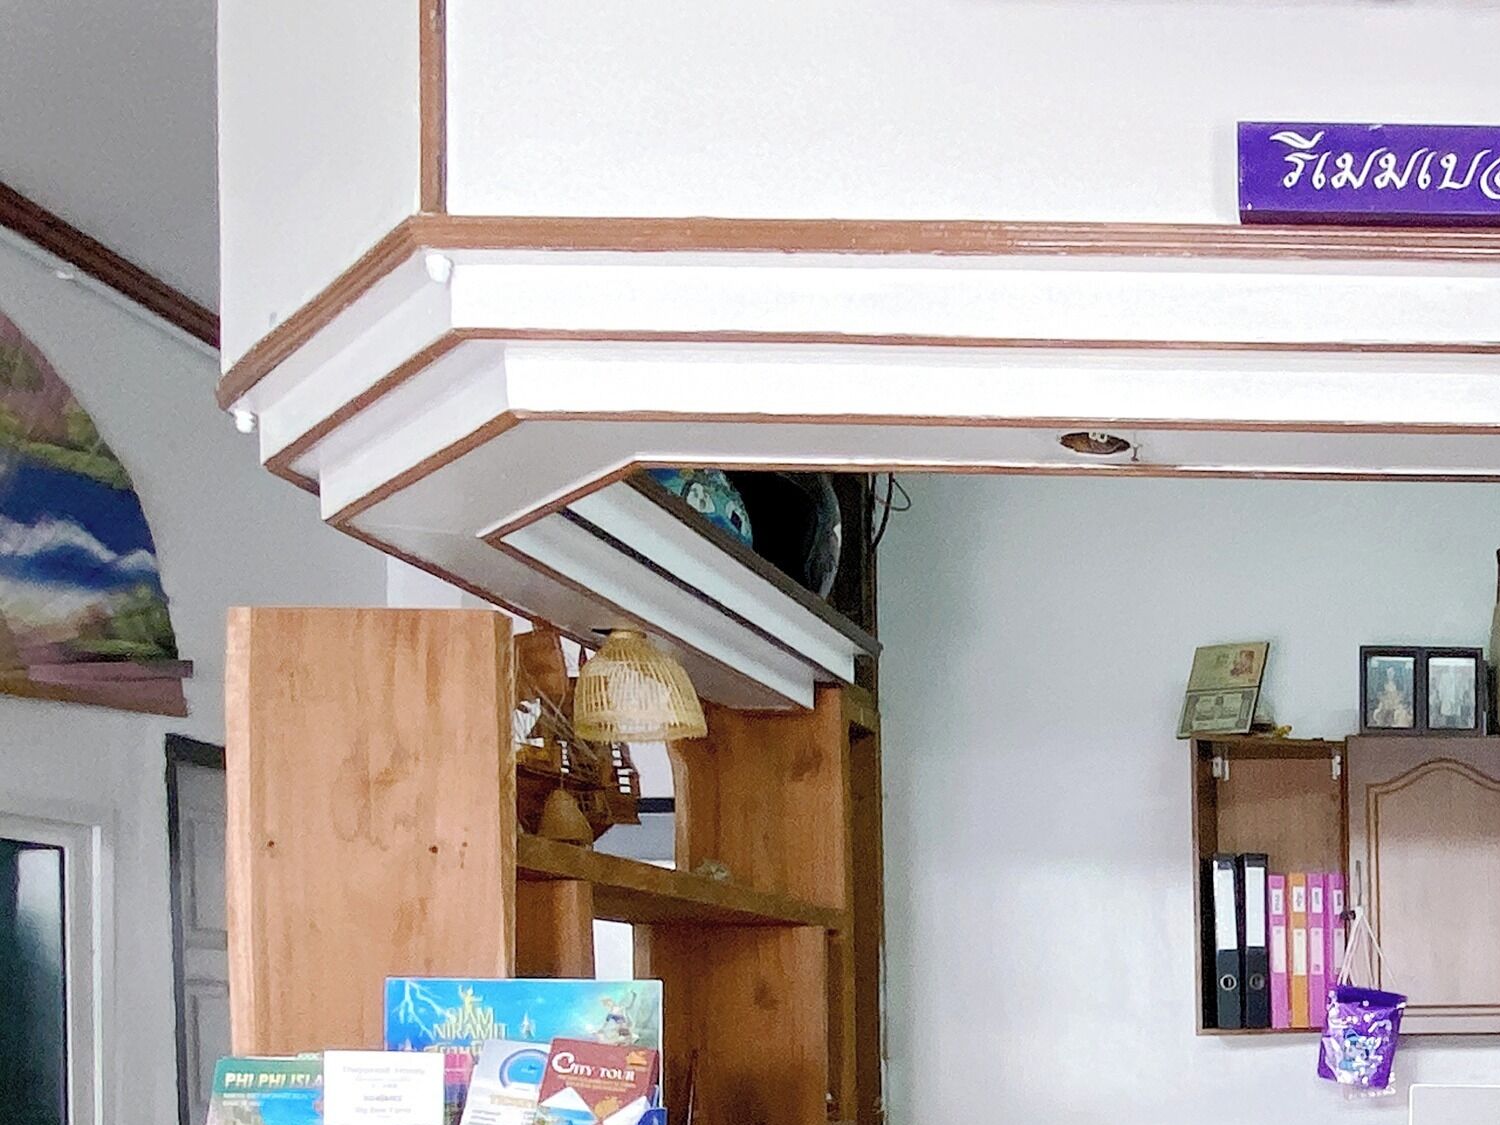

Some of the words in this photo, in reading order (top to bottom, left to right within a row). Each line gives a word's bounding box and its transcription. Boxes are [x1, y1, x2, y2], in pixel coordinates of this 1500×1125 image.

[444, 1006, 495, 1024] SIAM
[432, 1022, 508, 1041] NIRAMIT
[224, 1072, 256, 1089] PHI
[258, 1072, 288, 1089] PHI
[599, 1066, 636, 1083] TOUR
